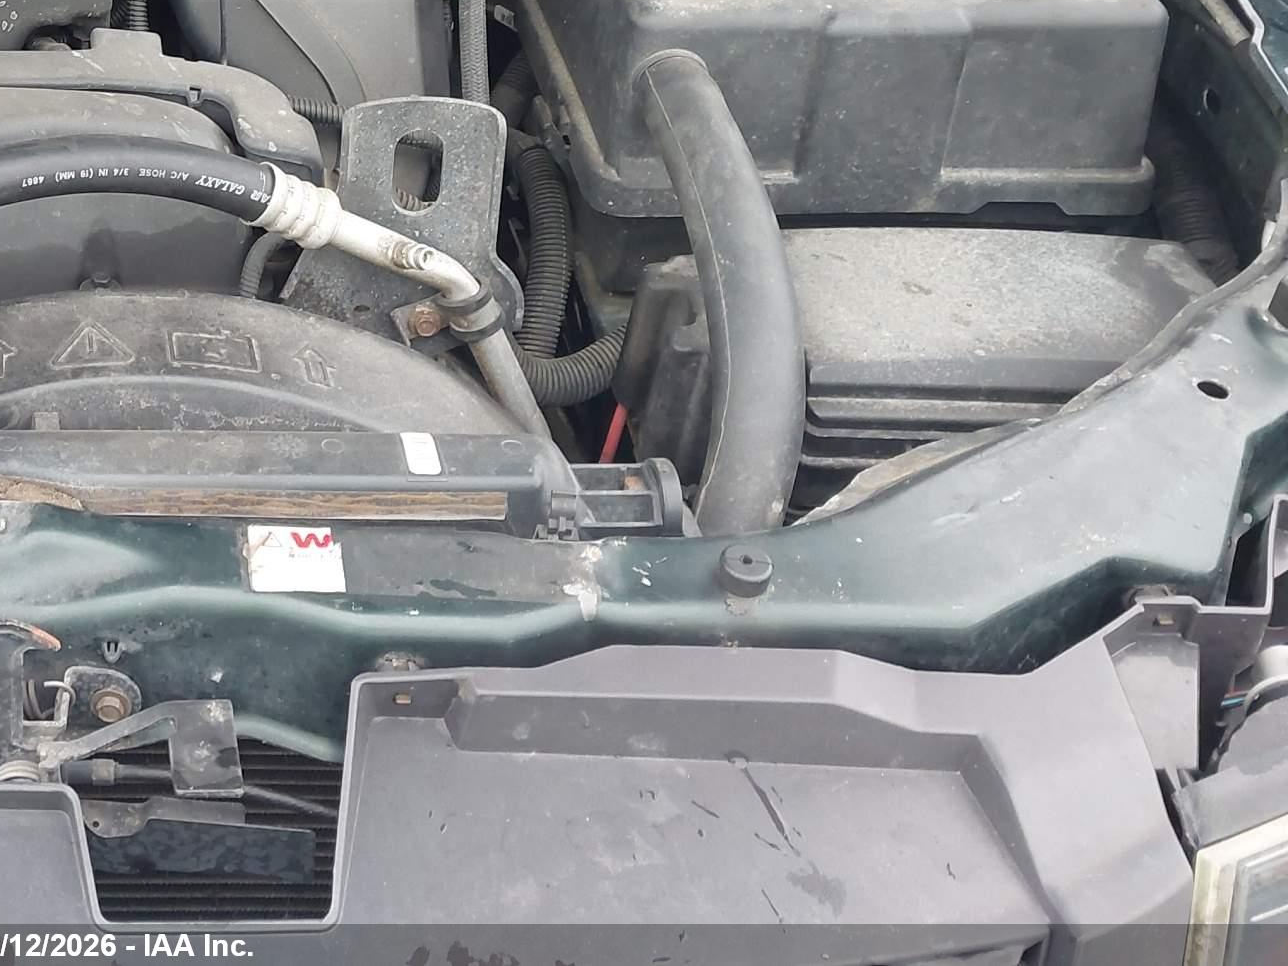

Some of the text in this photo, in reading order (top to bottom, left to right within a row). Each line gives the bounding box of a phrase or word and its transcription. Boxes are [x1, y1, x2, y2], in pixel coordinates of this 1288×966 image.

[54, 170, 76, 182] MM)
[79, 168, 93, 180] (19
[98, 167, 109, 177] IN
[113, 167, 129, 177] 3/4
[139, 168, 166, 178] HOSE
[170, 170, 189, 180] A/C
[195, 175, 245, 195] GALAXY
